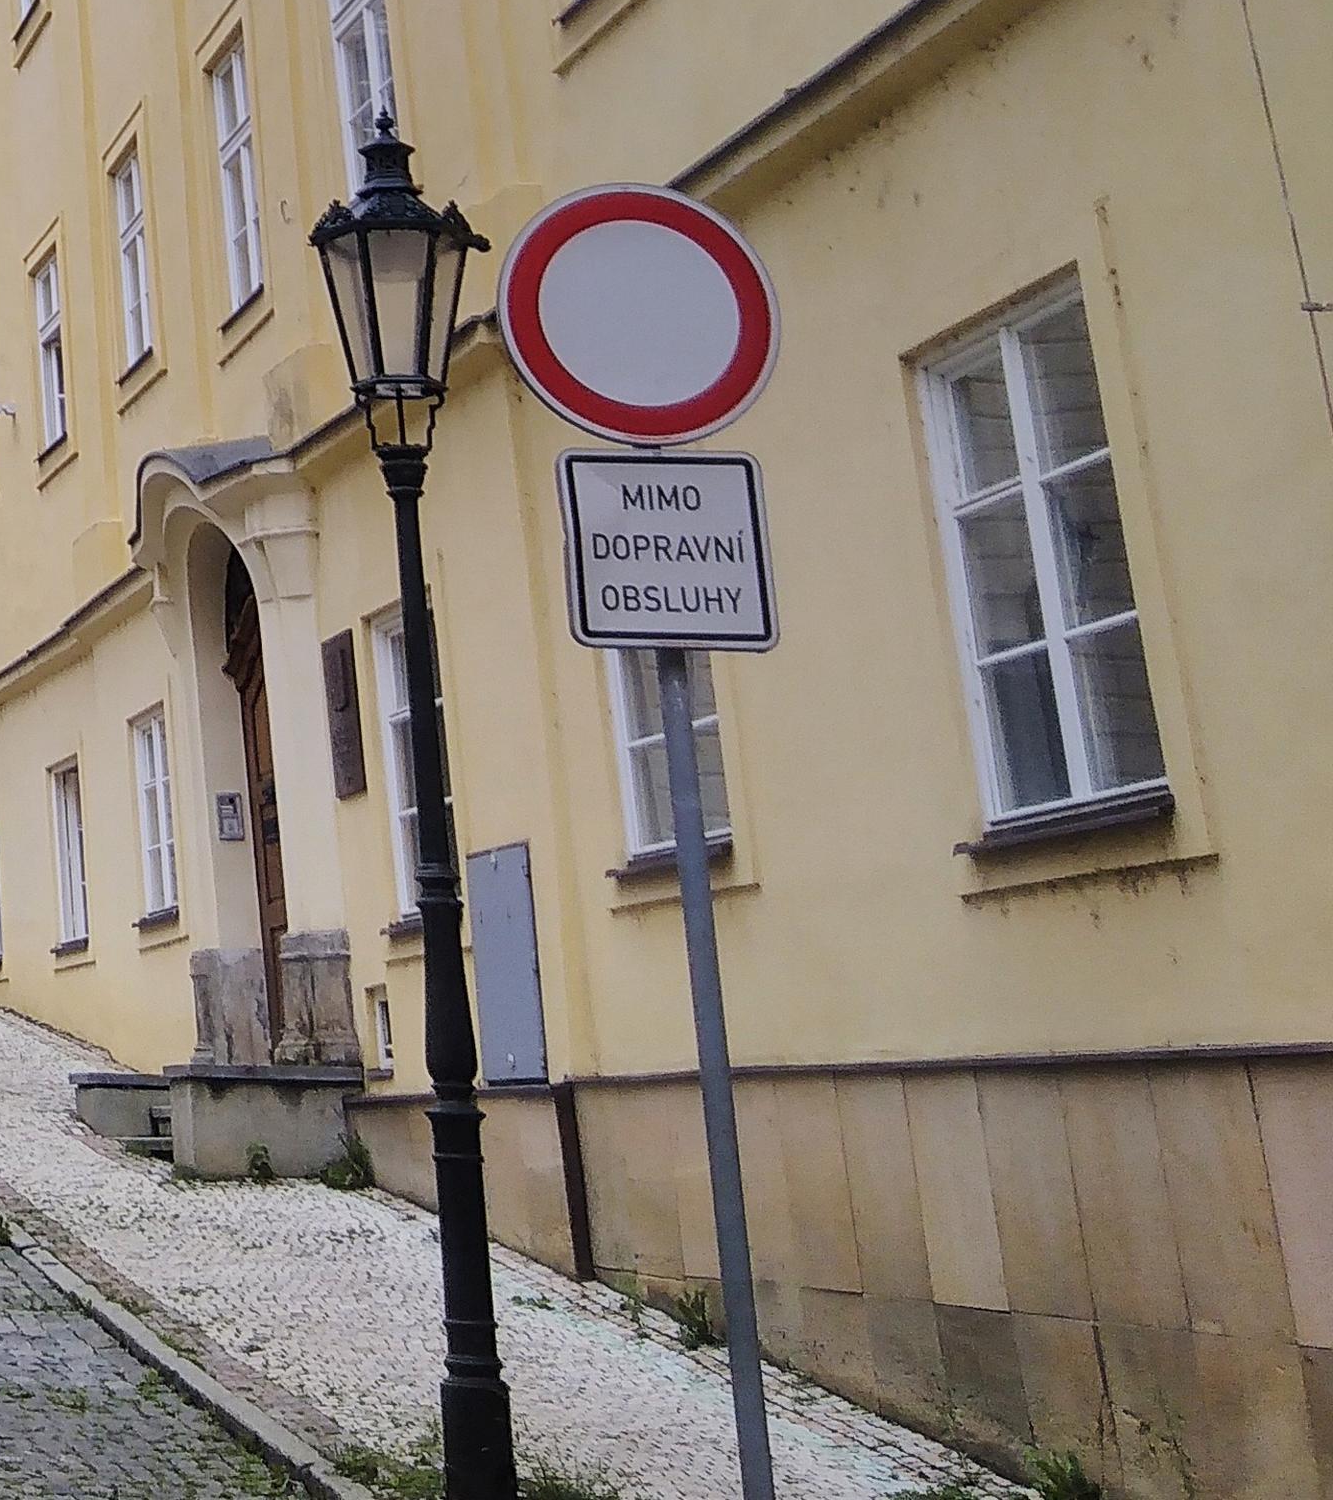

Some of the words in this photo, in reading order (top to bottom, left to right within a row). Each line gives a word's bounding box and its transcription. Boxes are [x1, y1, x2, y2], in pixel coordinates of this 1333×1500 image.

[620, 484, 702, 511] MIMO
[592, 530, 744, 563] DOPRAVNÍ
[601, 585, 742, 614] OBSLUHY
